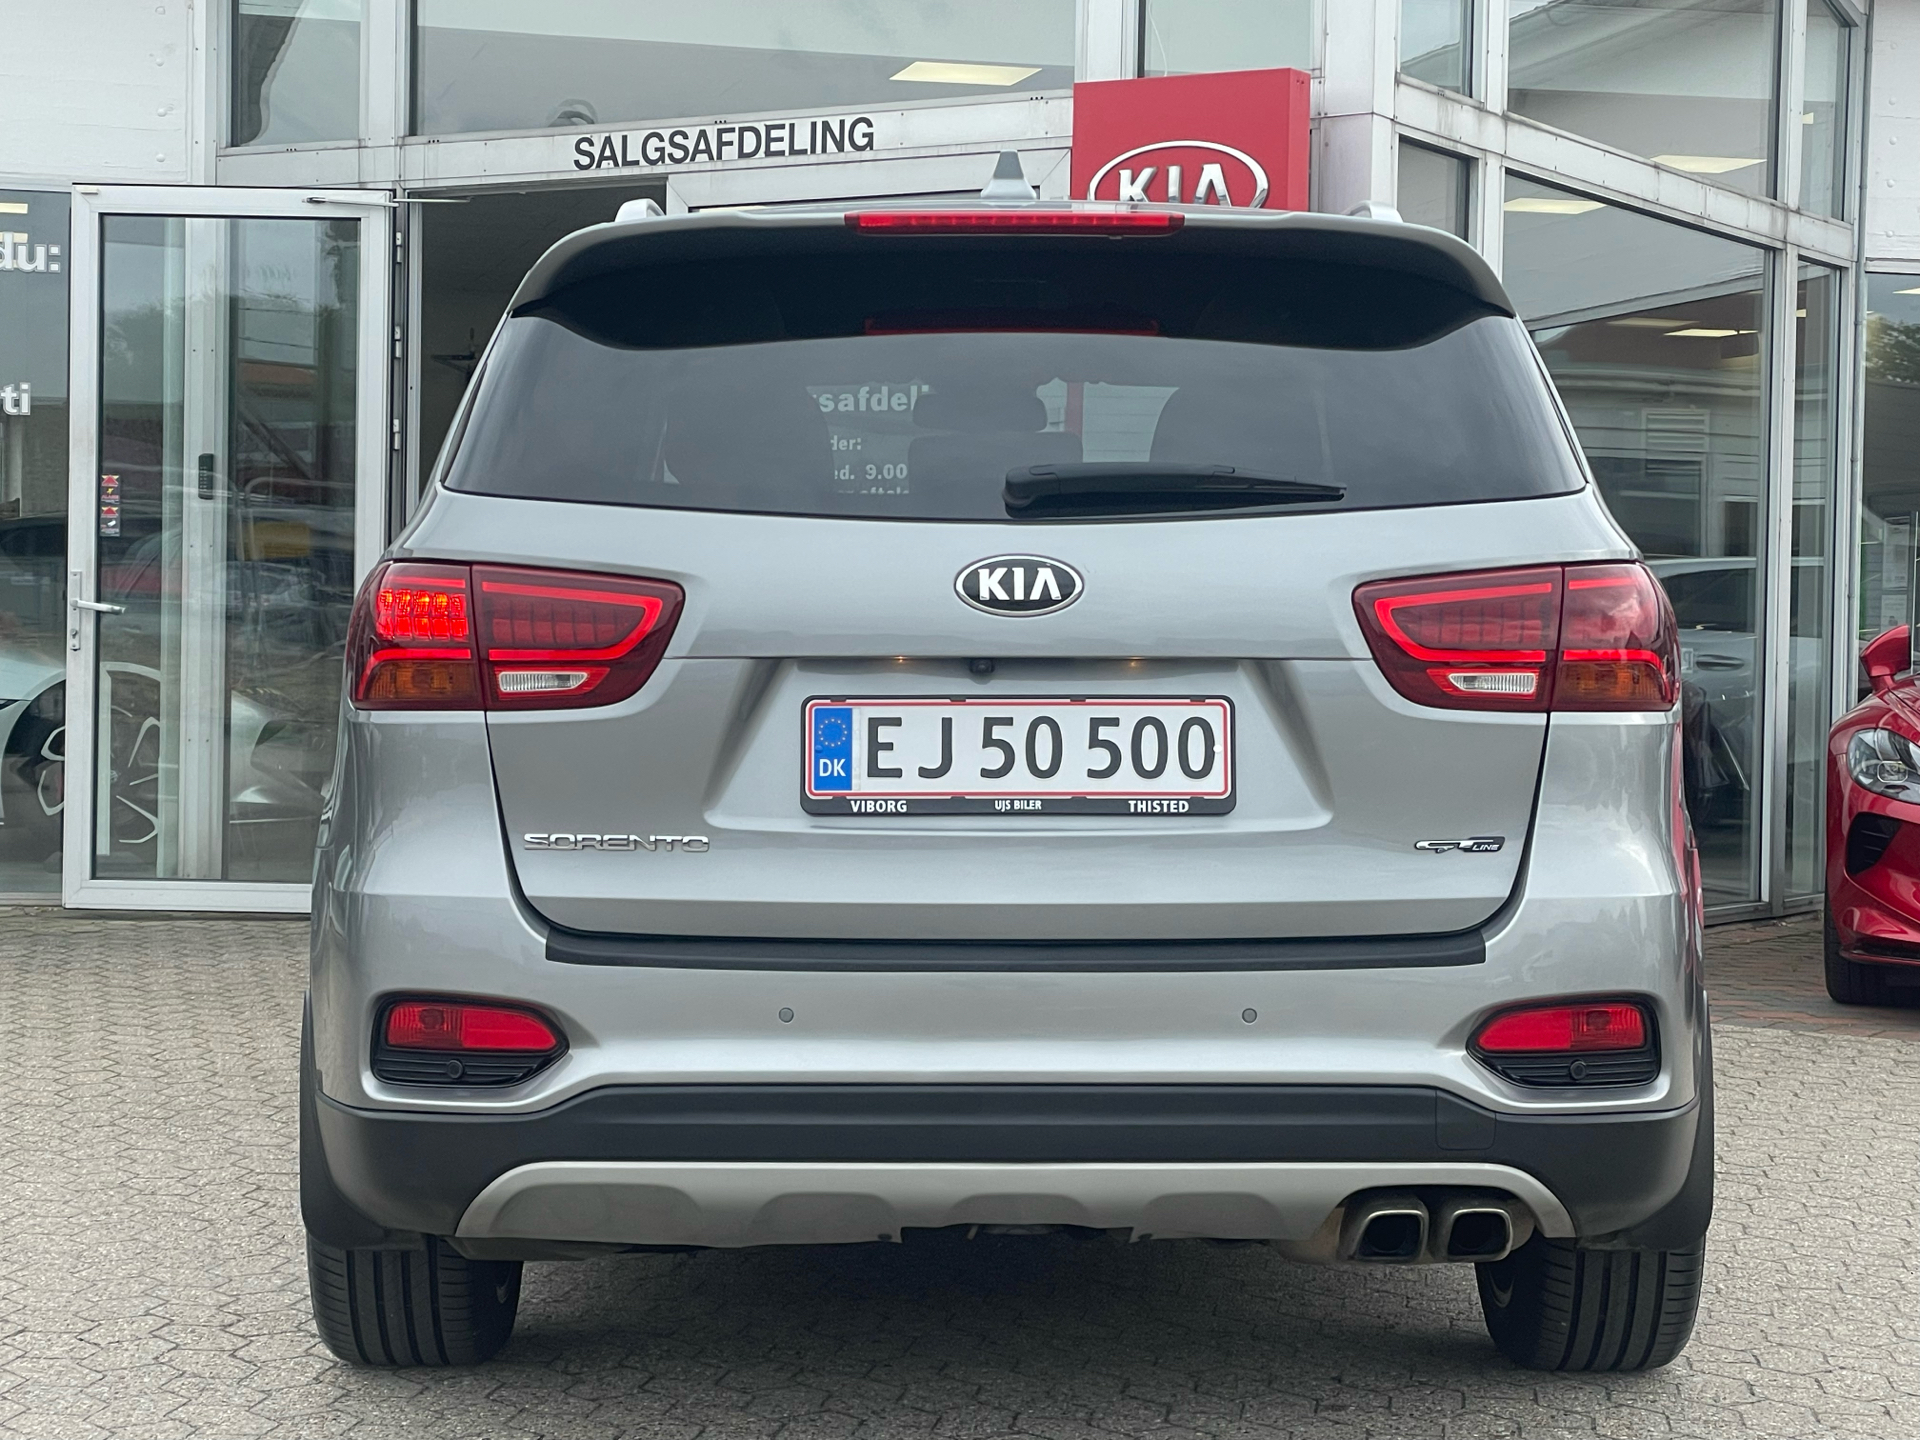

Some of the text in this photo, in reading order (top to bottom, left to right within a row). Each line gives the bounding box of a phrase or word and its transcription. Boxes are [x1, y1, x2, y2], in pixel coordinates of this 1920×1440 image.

[573, 117, 874, 170] SALGSAFDELING
[1119, 164, 1232, 207] KIA
[865, 464, 908, 479] 9.00
[978, 567, 1062, 600] KIA
[980, 716, 1063, 779] 50
[1087, 716, 1217, 779] 500
[819, 758, 847, 776] DK
[850, 800, 907, 813] VIBORG
[1013, 800, 1042, 810] BILER
[1128, 800, 1189, 813] THISTED
[524, 833, 709, 852] SORENTO
